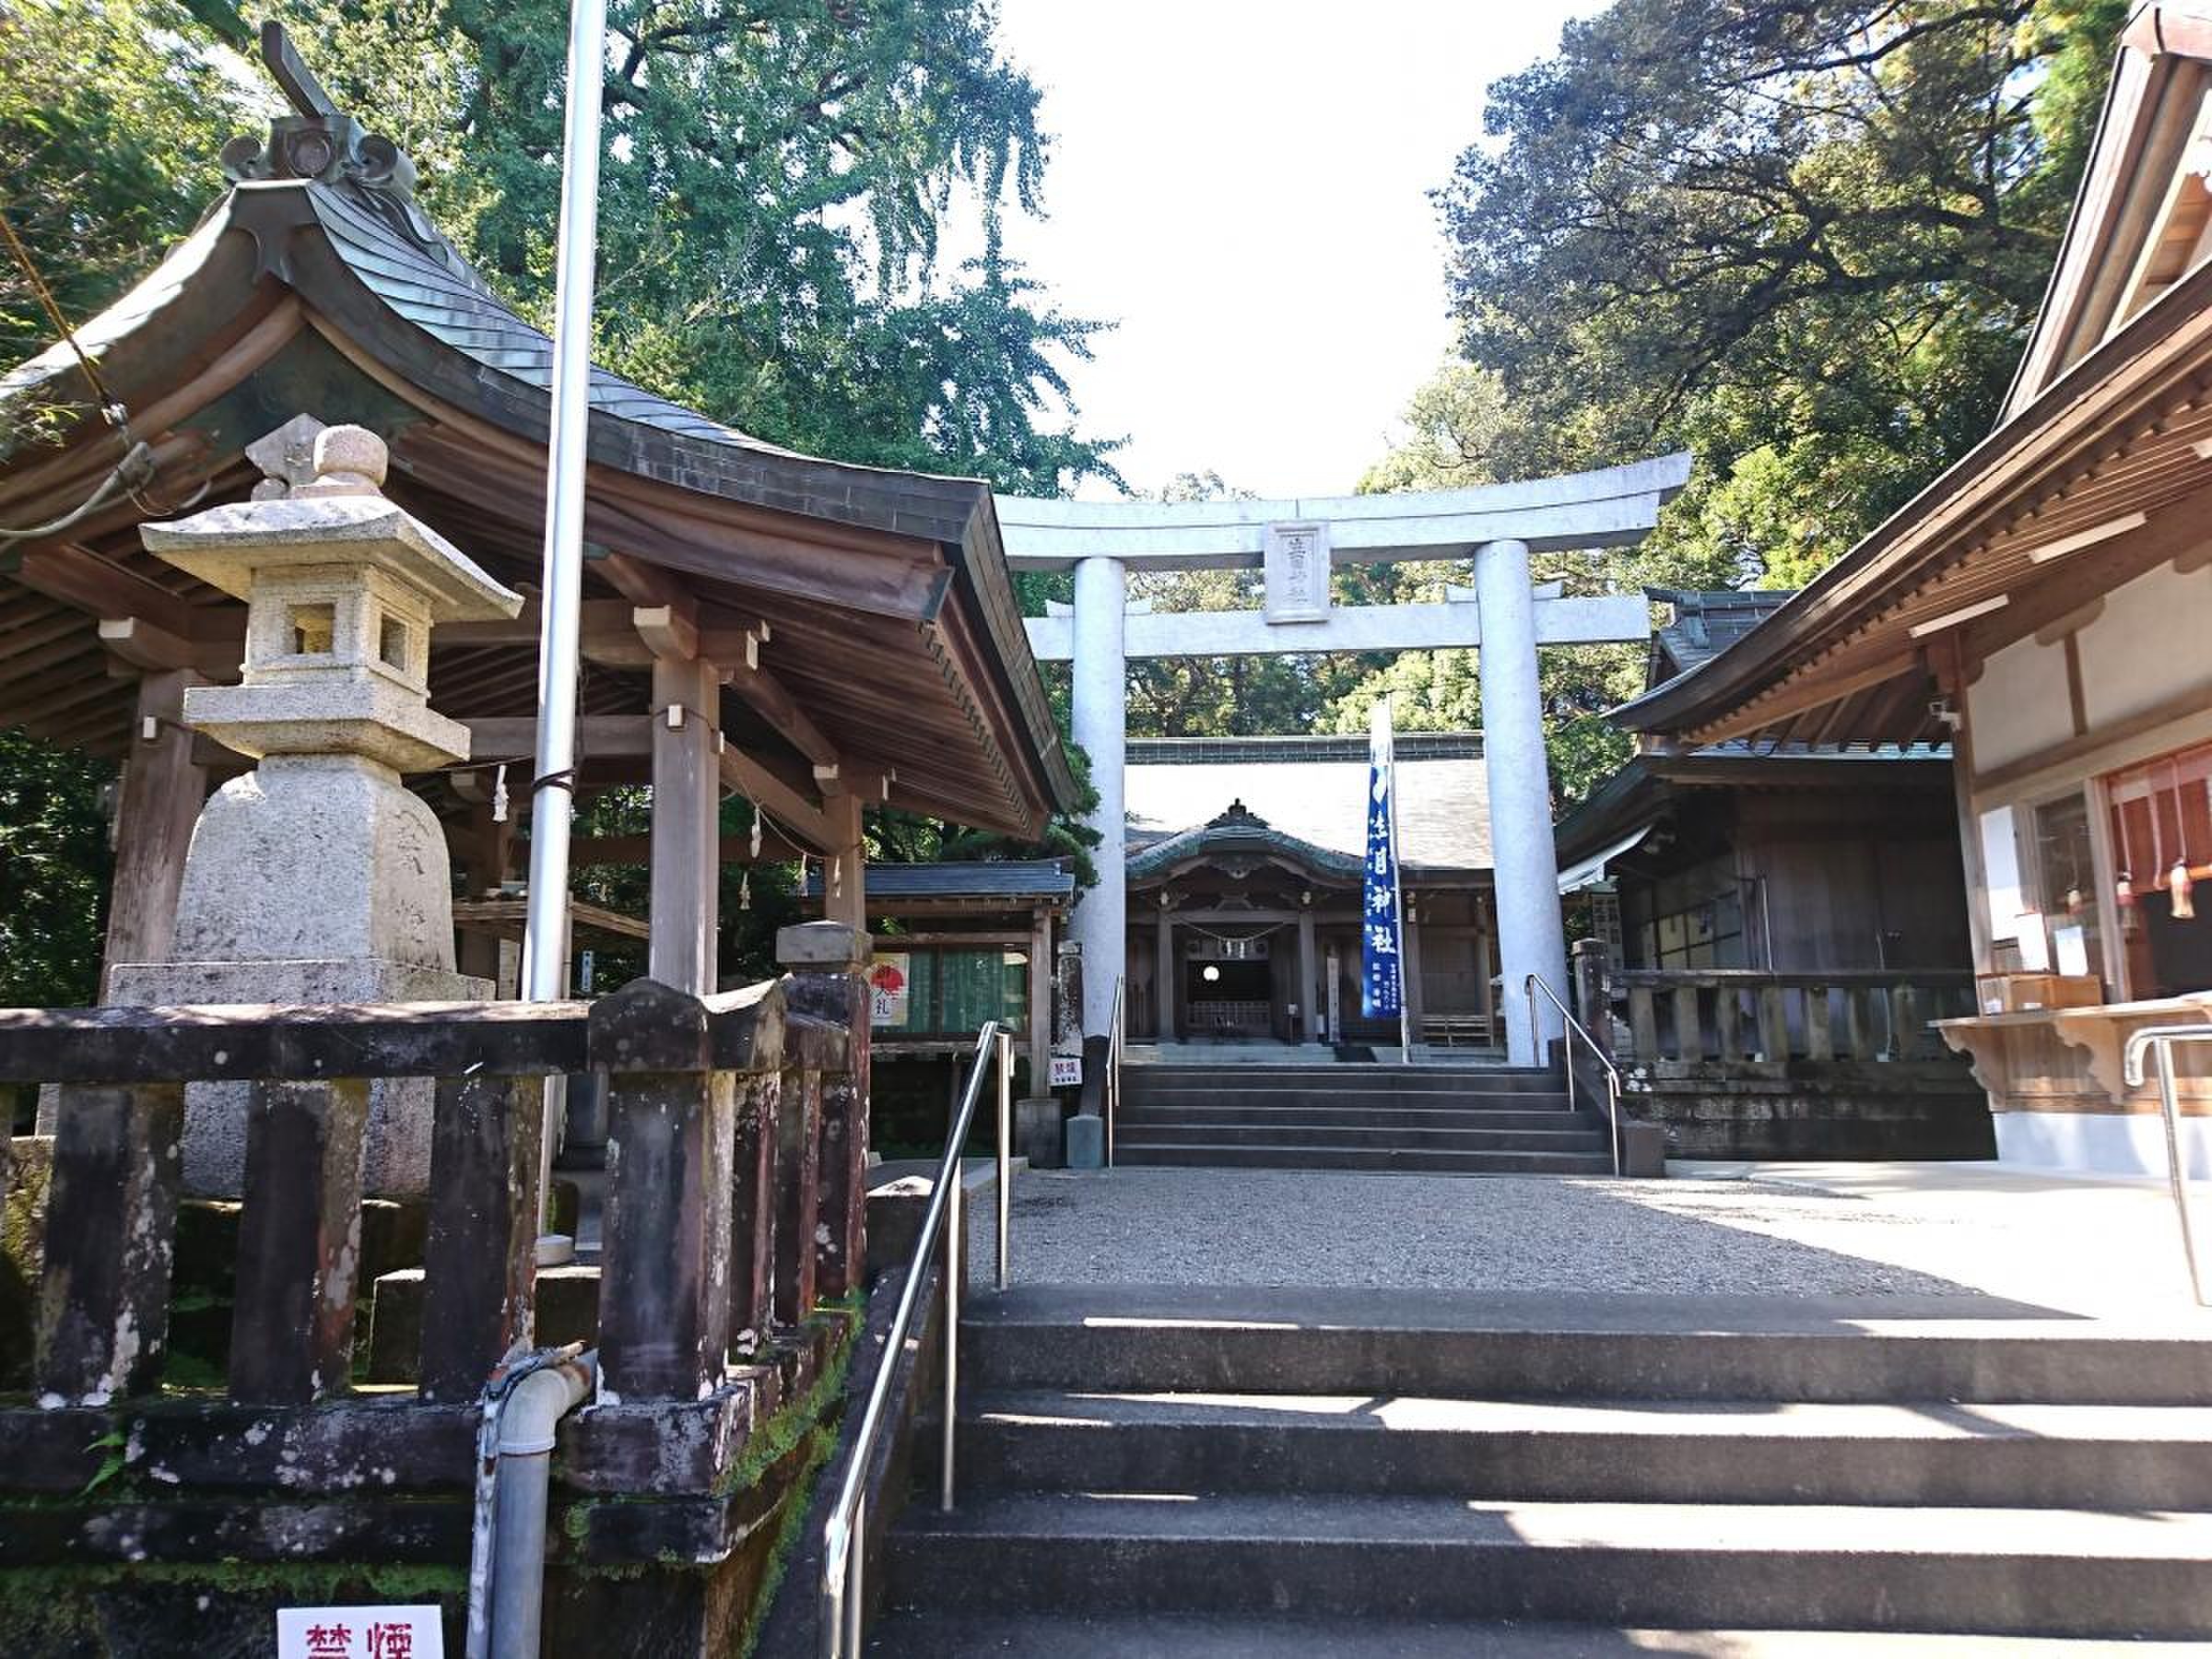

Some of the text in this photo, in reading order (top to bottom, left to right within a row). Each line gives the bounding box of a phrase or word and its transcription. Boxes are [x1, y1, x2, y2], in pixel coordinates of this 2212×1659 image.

[1371, 810, 1396, 954] 生目神社
[306, 1622, 412, 1659] 禁煙
